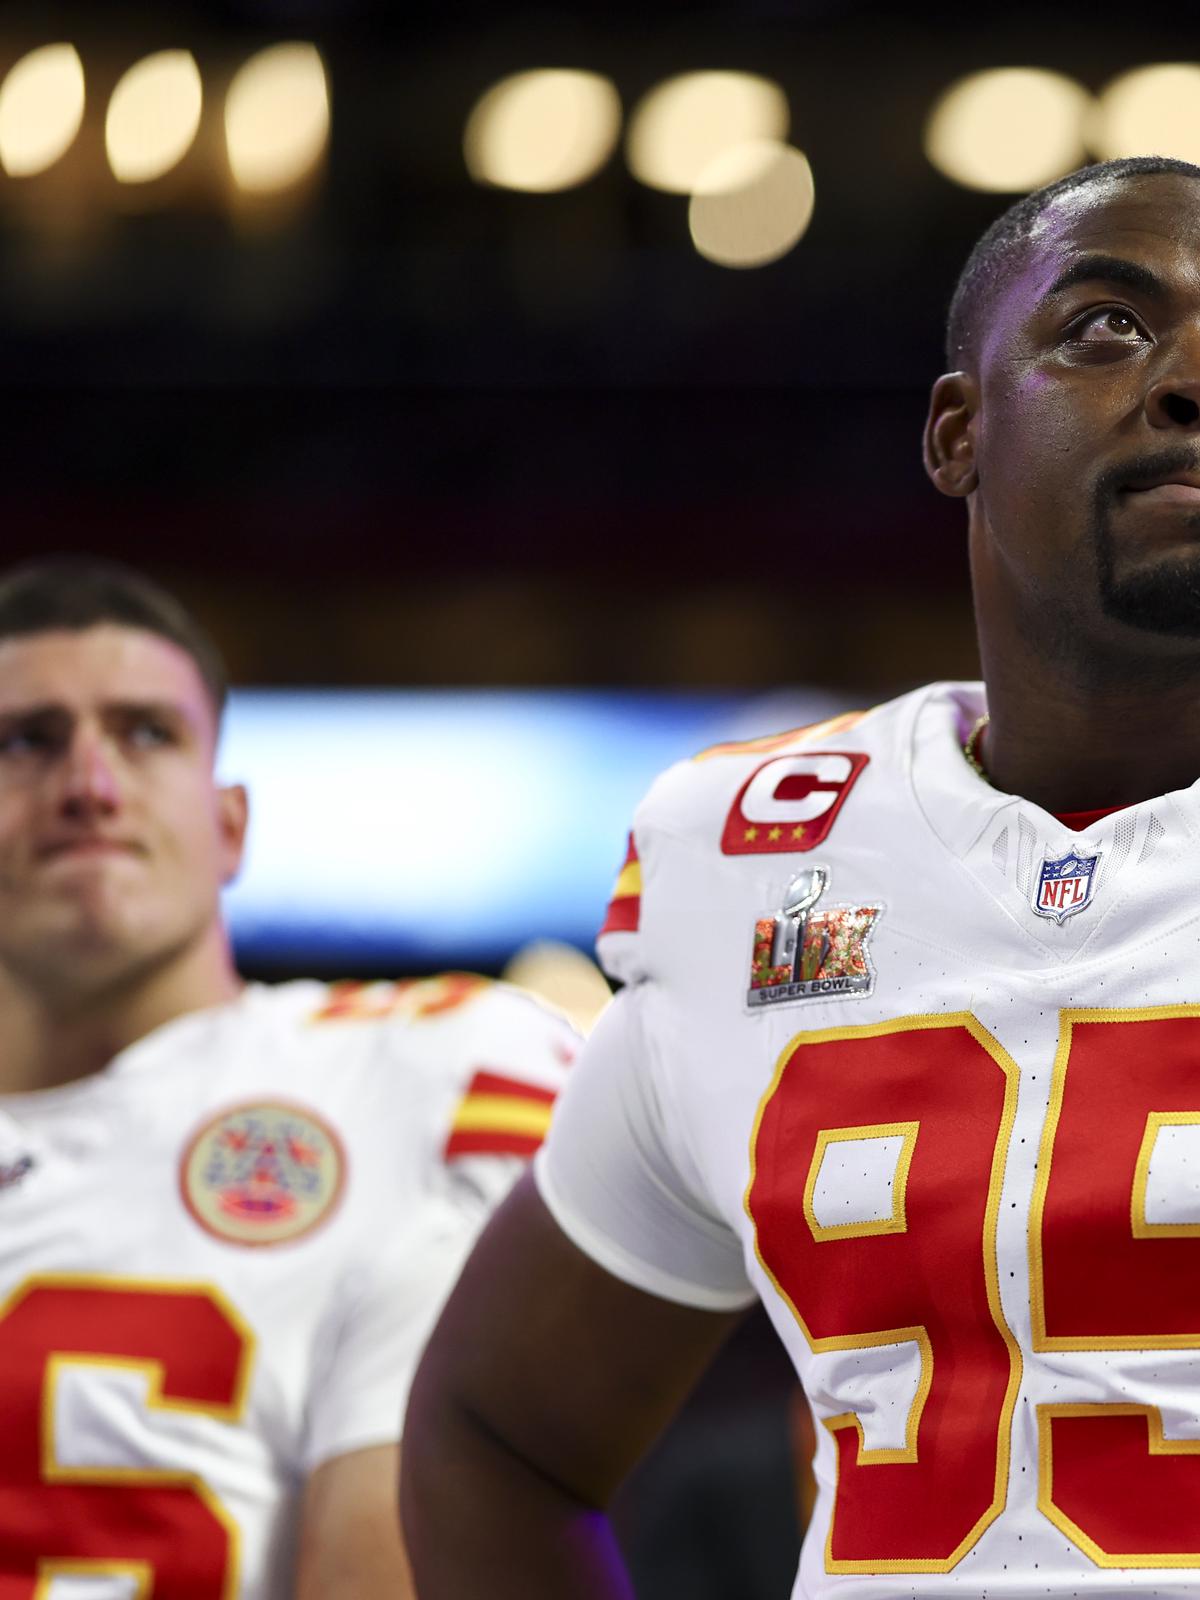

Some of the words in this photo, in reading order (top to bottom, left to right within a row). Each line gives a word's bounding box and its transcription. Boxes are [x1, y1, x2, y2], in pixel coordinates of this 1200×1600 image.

[740, 754, 853, 824] C
[1041, 878, 1084, 909] NFL
[760, 984, 806, 1000] SUPER
[811, 978, 854, 992] BOWL
